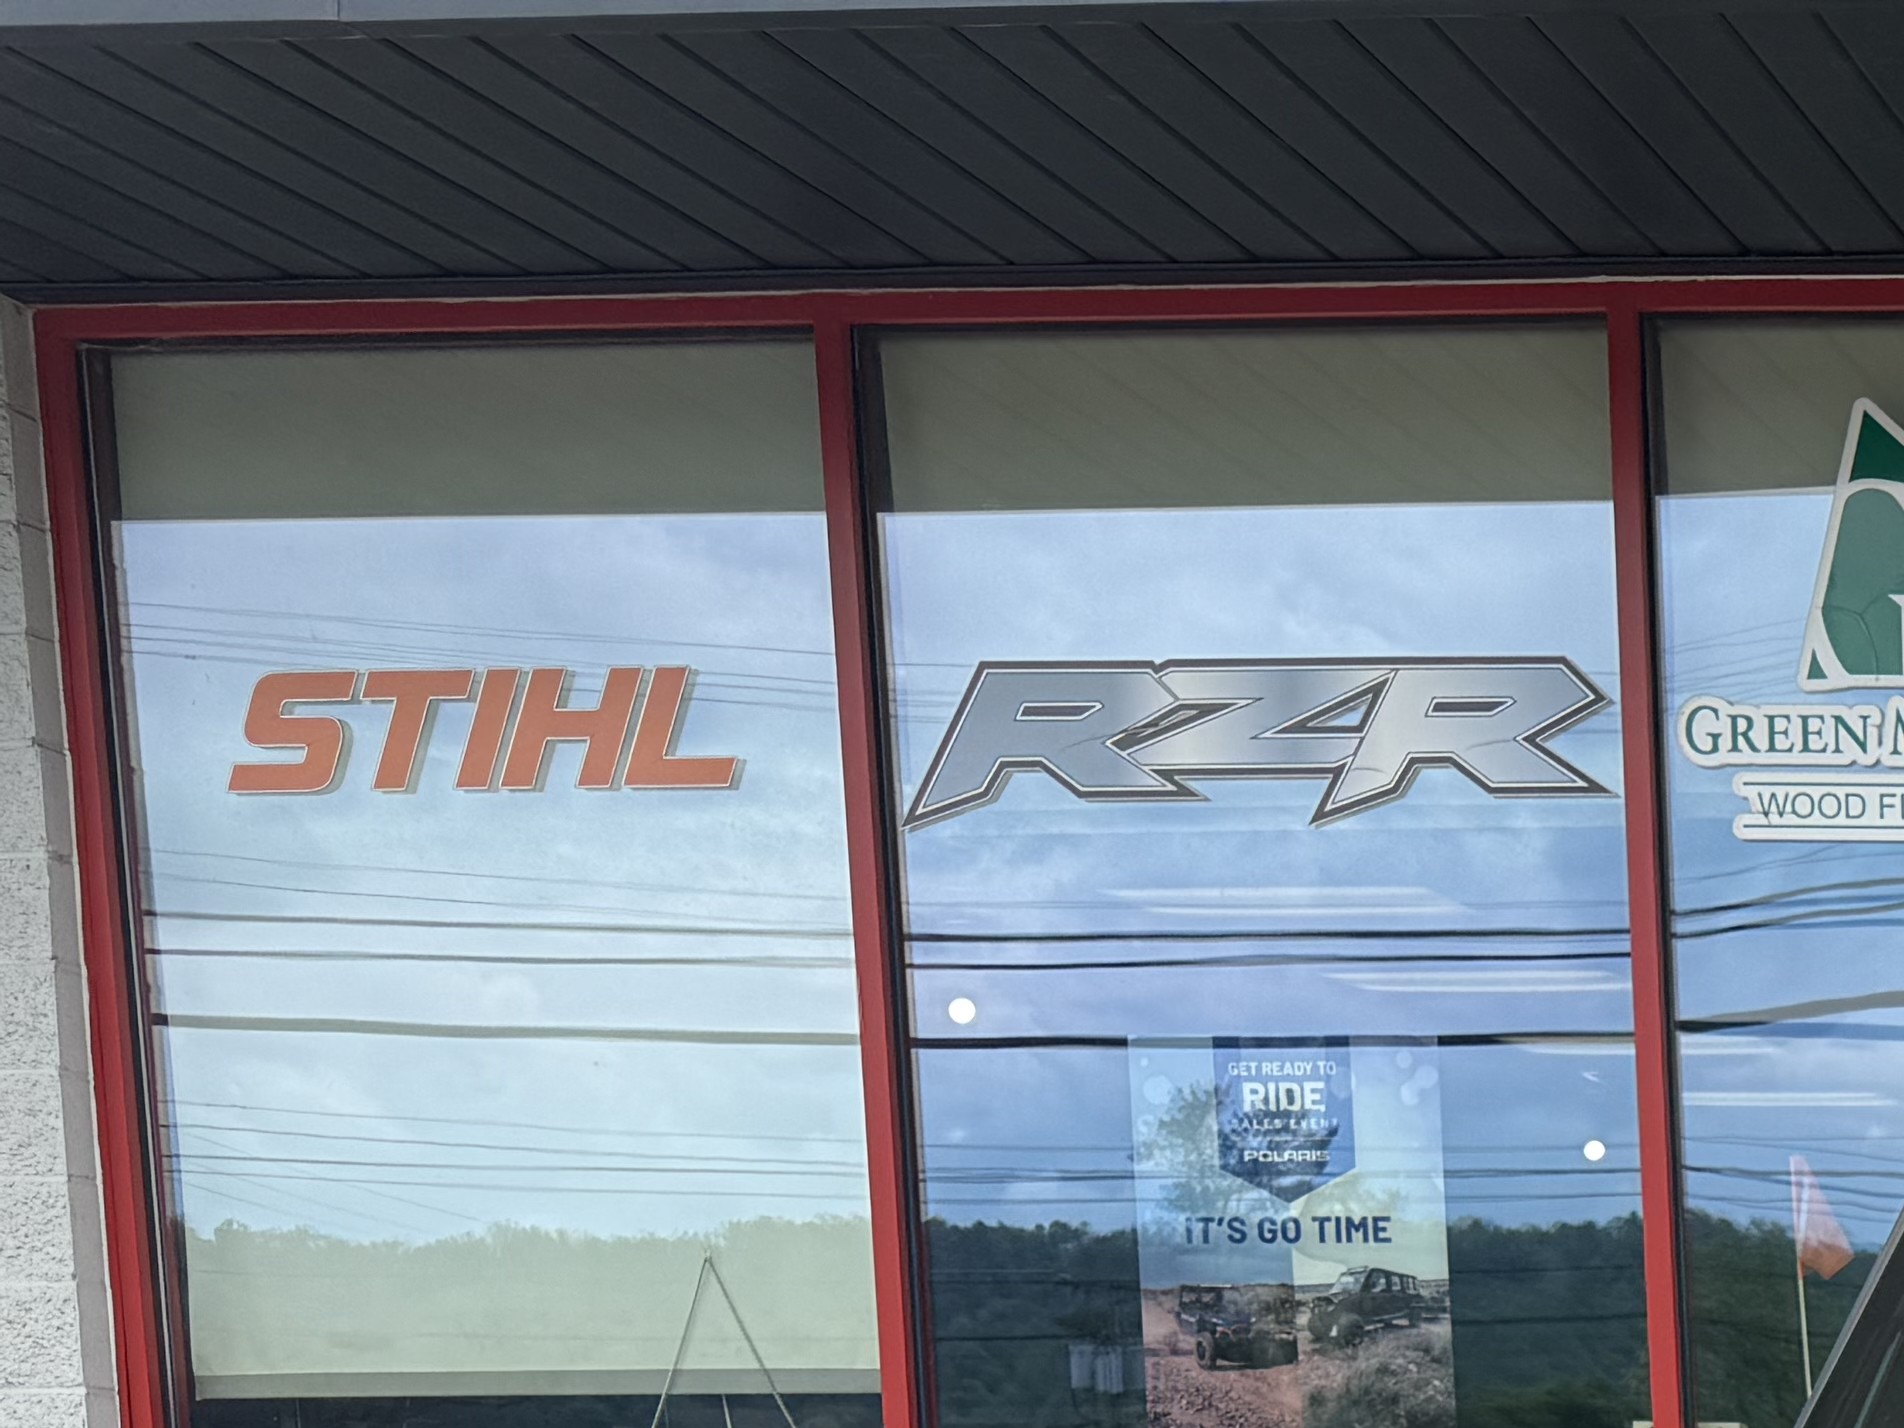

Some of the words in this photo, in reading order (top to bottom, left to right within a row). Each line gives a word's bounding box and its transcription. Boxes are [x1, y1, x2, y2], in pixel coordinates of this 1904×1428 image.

[227, 665, 744, 793] STIHL
[902, 656, 1620, 830] RZR
[1684, 705, 1873, 757] GREEN
[1757, 791, 1867, 822] WOOD
[1228, 1062, 1257, 1076] GET
[1261, 1062, 1313, 1075] READY
[1316, 1061, 1337, 1075] TO
[1242, 1081, 1326, 1113] RIDE
[1243, 1150, 1331, 1163] POLARIS
[1185, 1216, 1248, 1245] IT'S
[1257, 1216, 1302, 1245] GO
[1311, 1216, 1393, 1244] TIME
